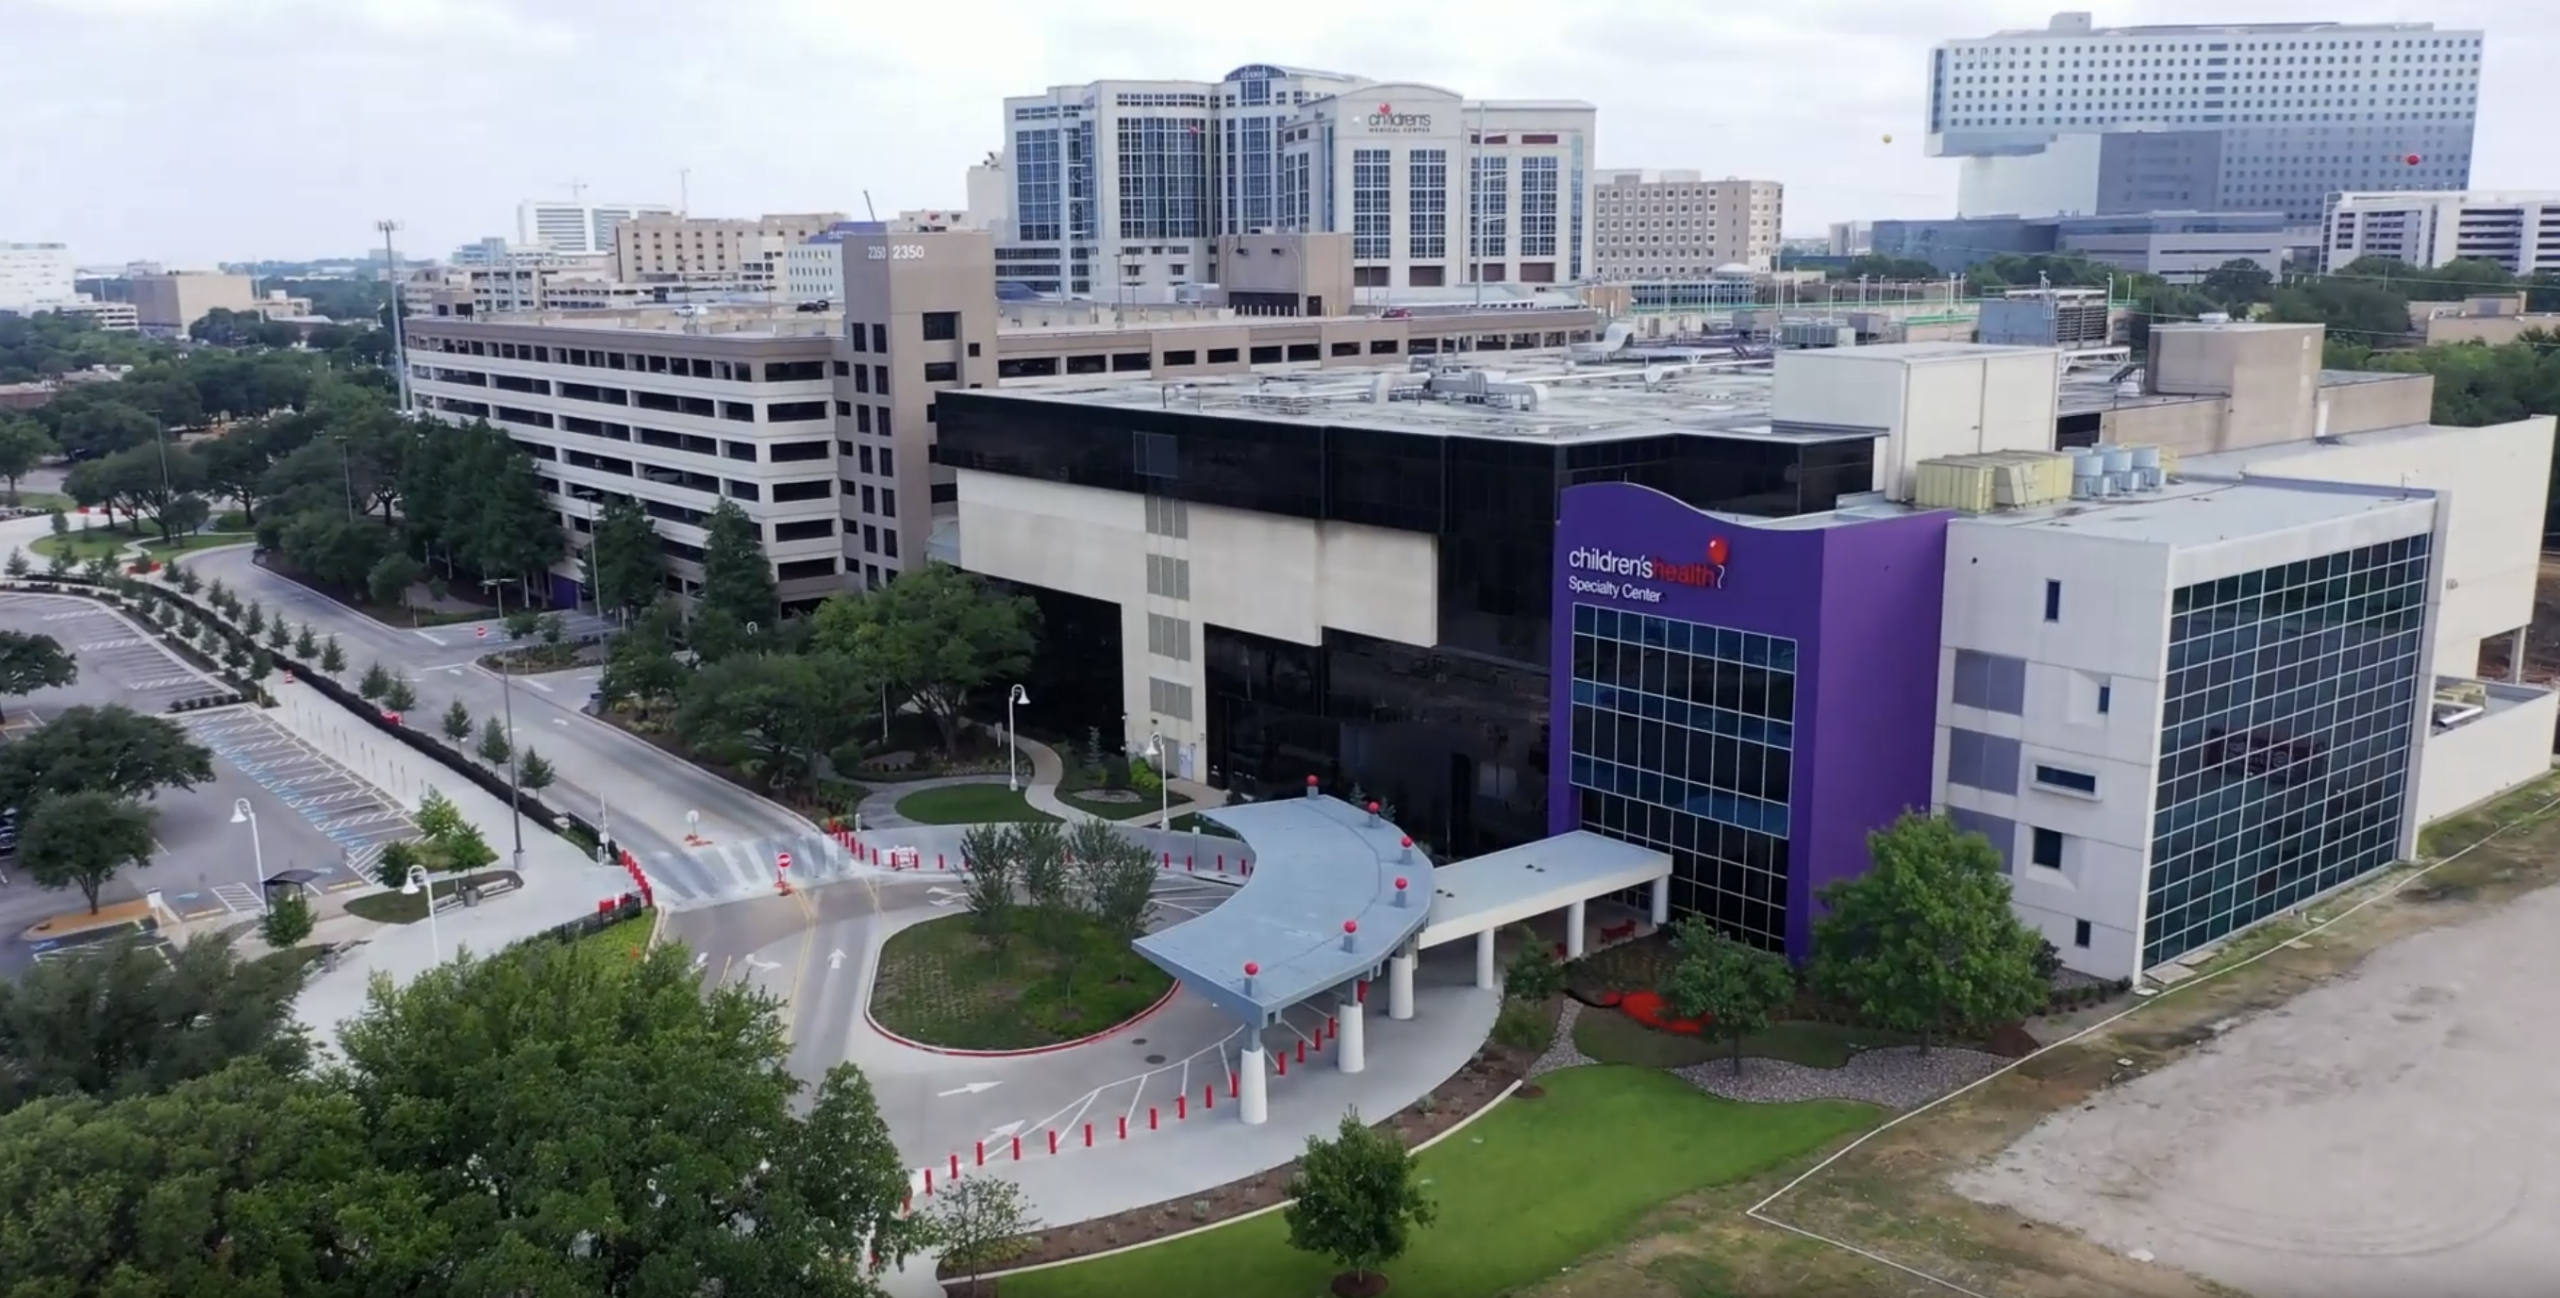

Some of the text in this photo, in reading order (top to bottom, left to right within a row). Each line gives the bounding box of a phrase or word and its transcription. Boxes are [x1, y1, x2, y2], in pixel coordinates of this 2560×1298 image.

[867, 245, 887, 260] 2350
[892, 245, 925, 259] 2350
[1568, 546, 1717, 588] children's health
[1568, 575, 1663, 602] Specialty Center
